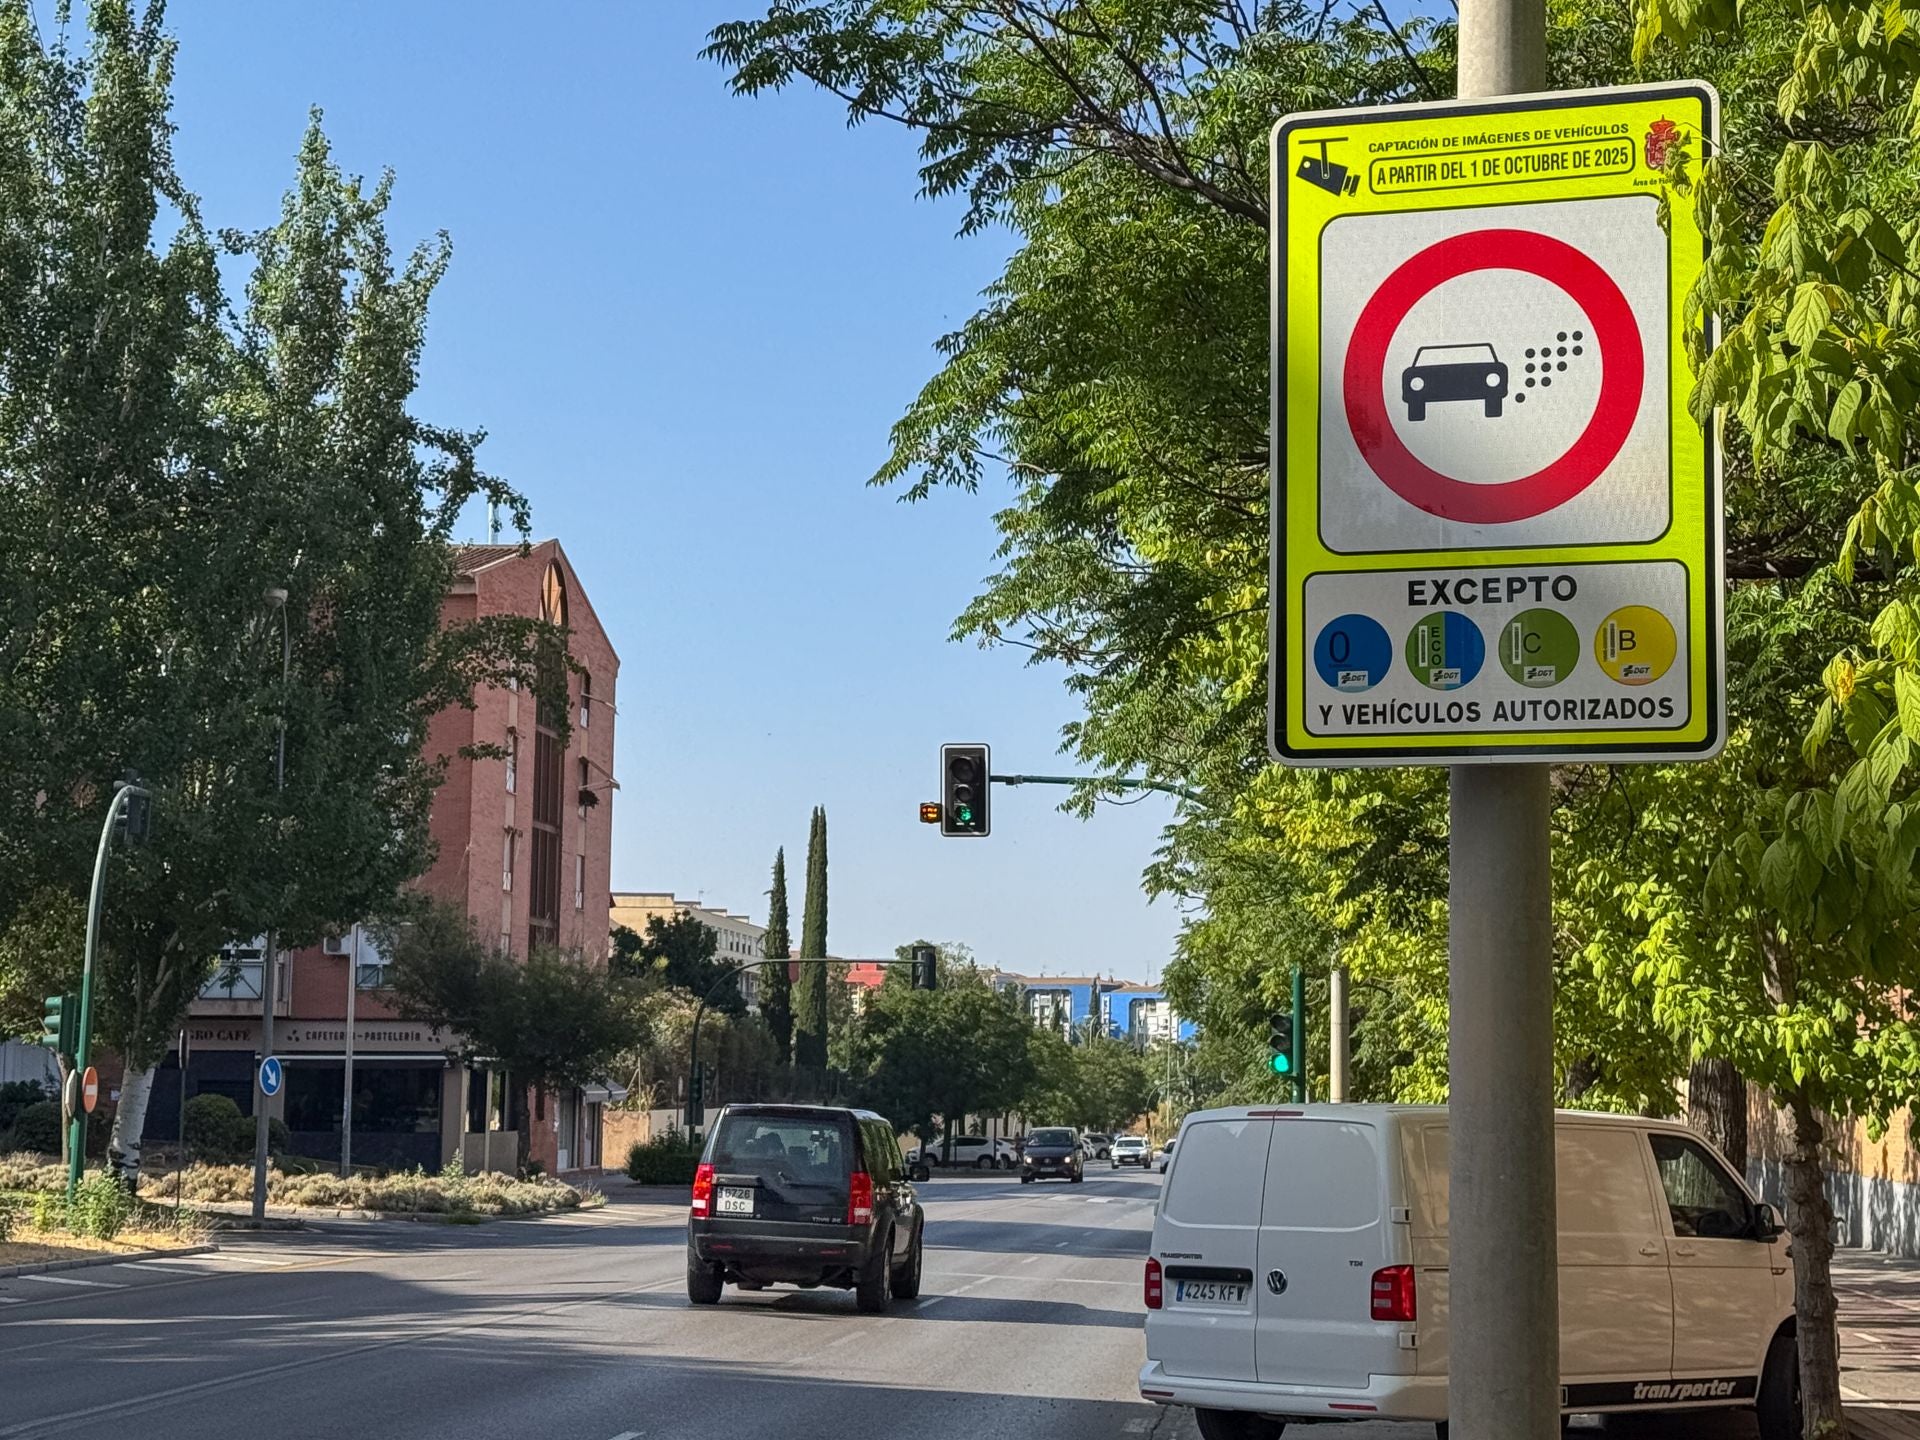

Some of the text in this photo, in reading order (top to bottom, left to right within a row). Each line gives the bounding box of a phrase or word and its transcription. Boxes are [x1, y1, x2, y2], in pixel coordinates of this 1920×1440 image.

[1368, 123, 1629, 153] CAPTACIÓN DE IMÁGENES DE VEHÍCULOS
[1376, 147, 1628, 185] A PARTIR DEL 1 DE OCTUBRE DE 2025
[1407, 575, 1578, 607] EXCEPTO
[1329, 631, 1350, 663] 0
[1522, 632, 1541, 654] C
[1618, 629, 1636, 651] B
[1443, 671, 1459, 679] DGT
[1537, 669, 1553, 677] DGT
[1633, 666, 1650, 674] DGT
[1318, 696, 1674, 725] Y VEHÍCULOS AUTORIZADOS
[725, 1200, 745, 1211] DSC
[1185, 1282, 1215, 1300] 4245
[1634, 1379, 1736, 1400] transporter
